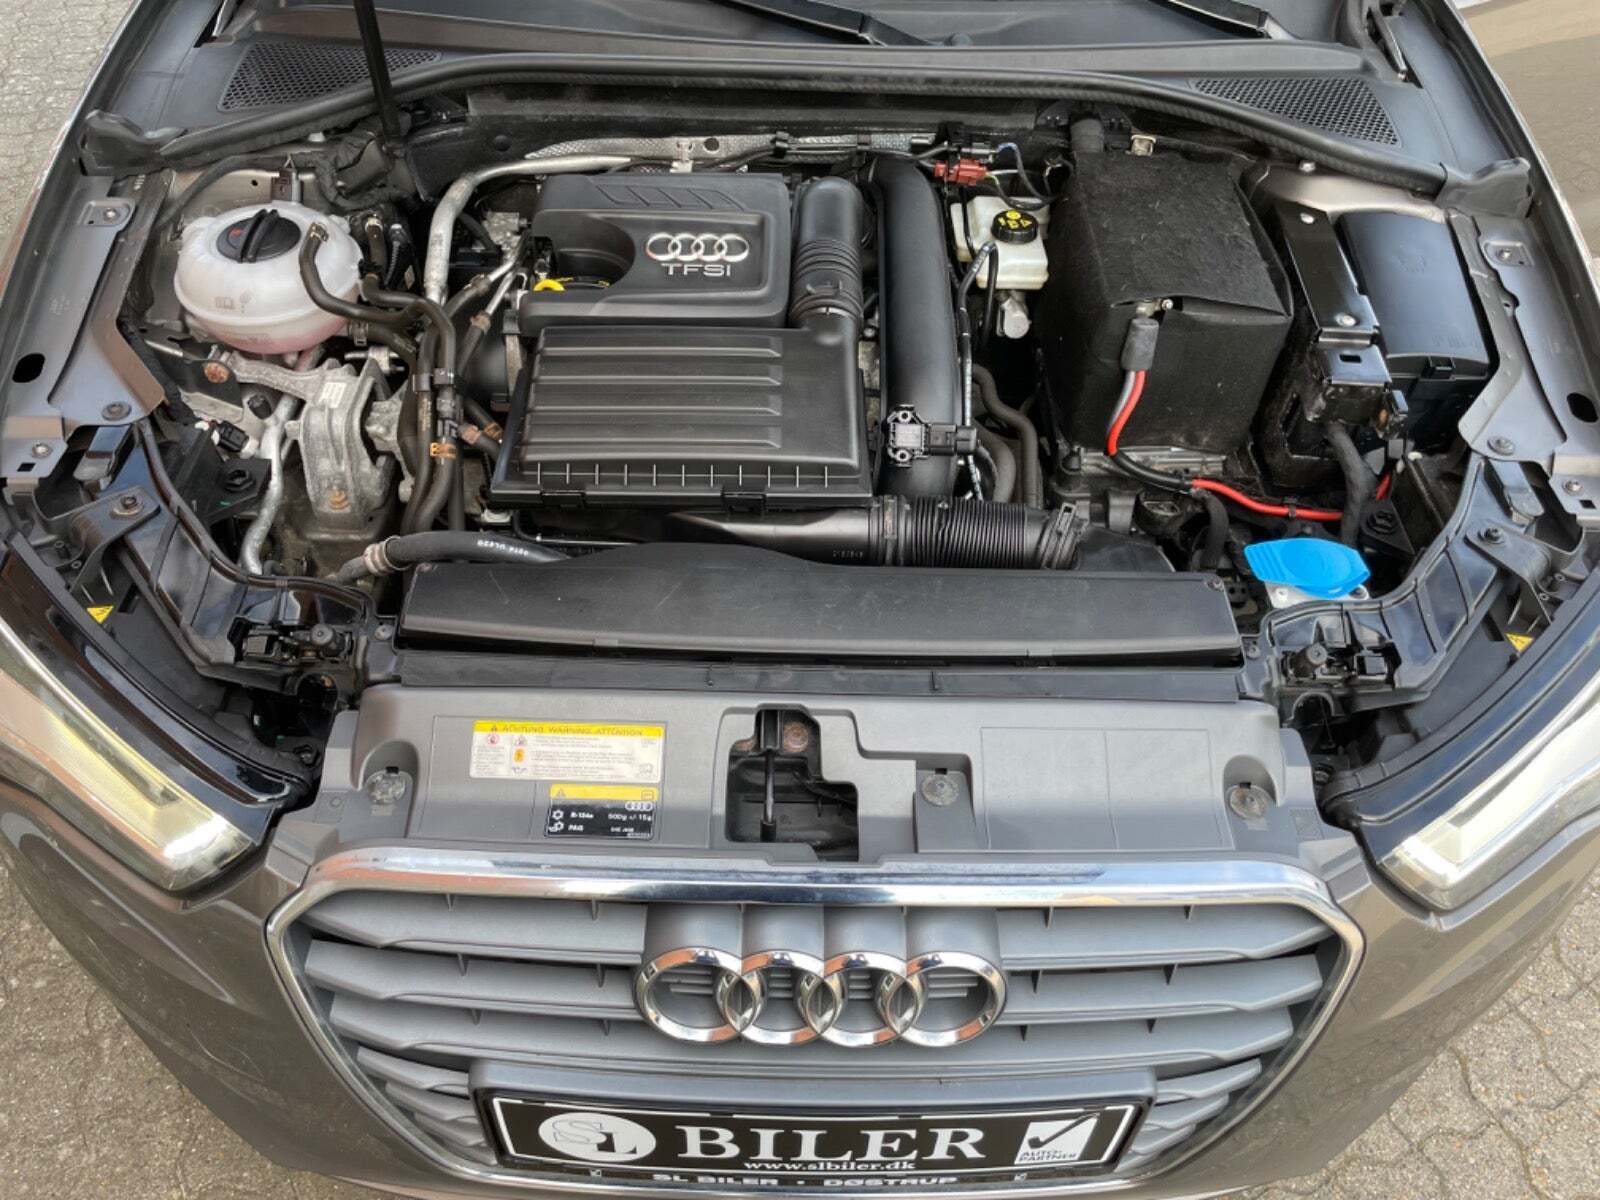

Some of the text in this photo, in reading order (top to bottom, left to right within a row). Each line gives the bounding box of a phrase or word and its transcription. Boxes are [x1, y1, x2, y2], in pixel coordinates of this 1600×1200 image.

[661, 263, 731, 276] TFSI
[675, 1125, 985, 1161] BILER
[744, 1161, 916, 1171] www.slbiler.dk
[698, 1175, 778, 1185] BILER
